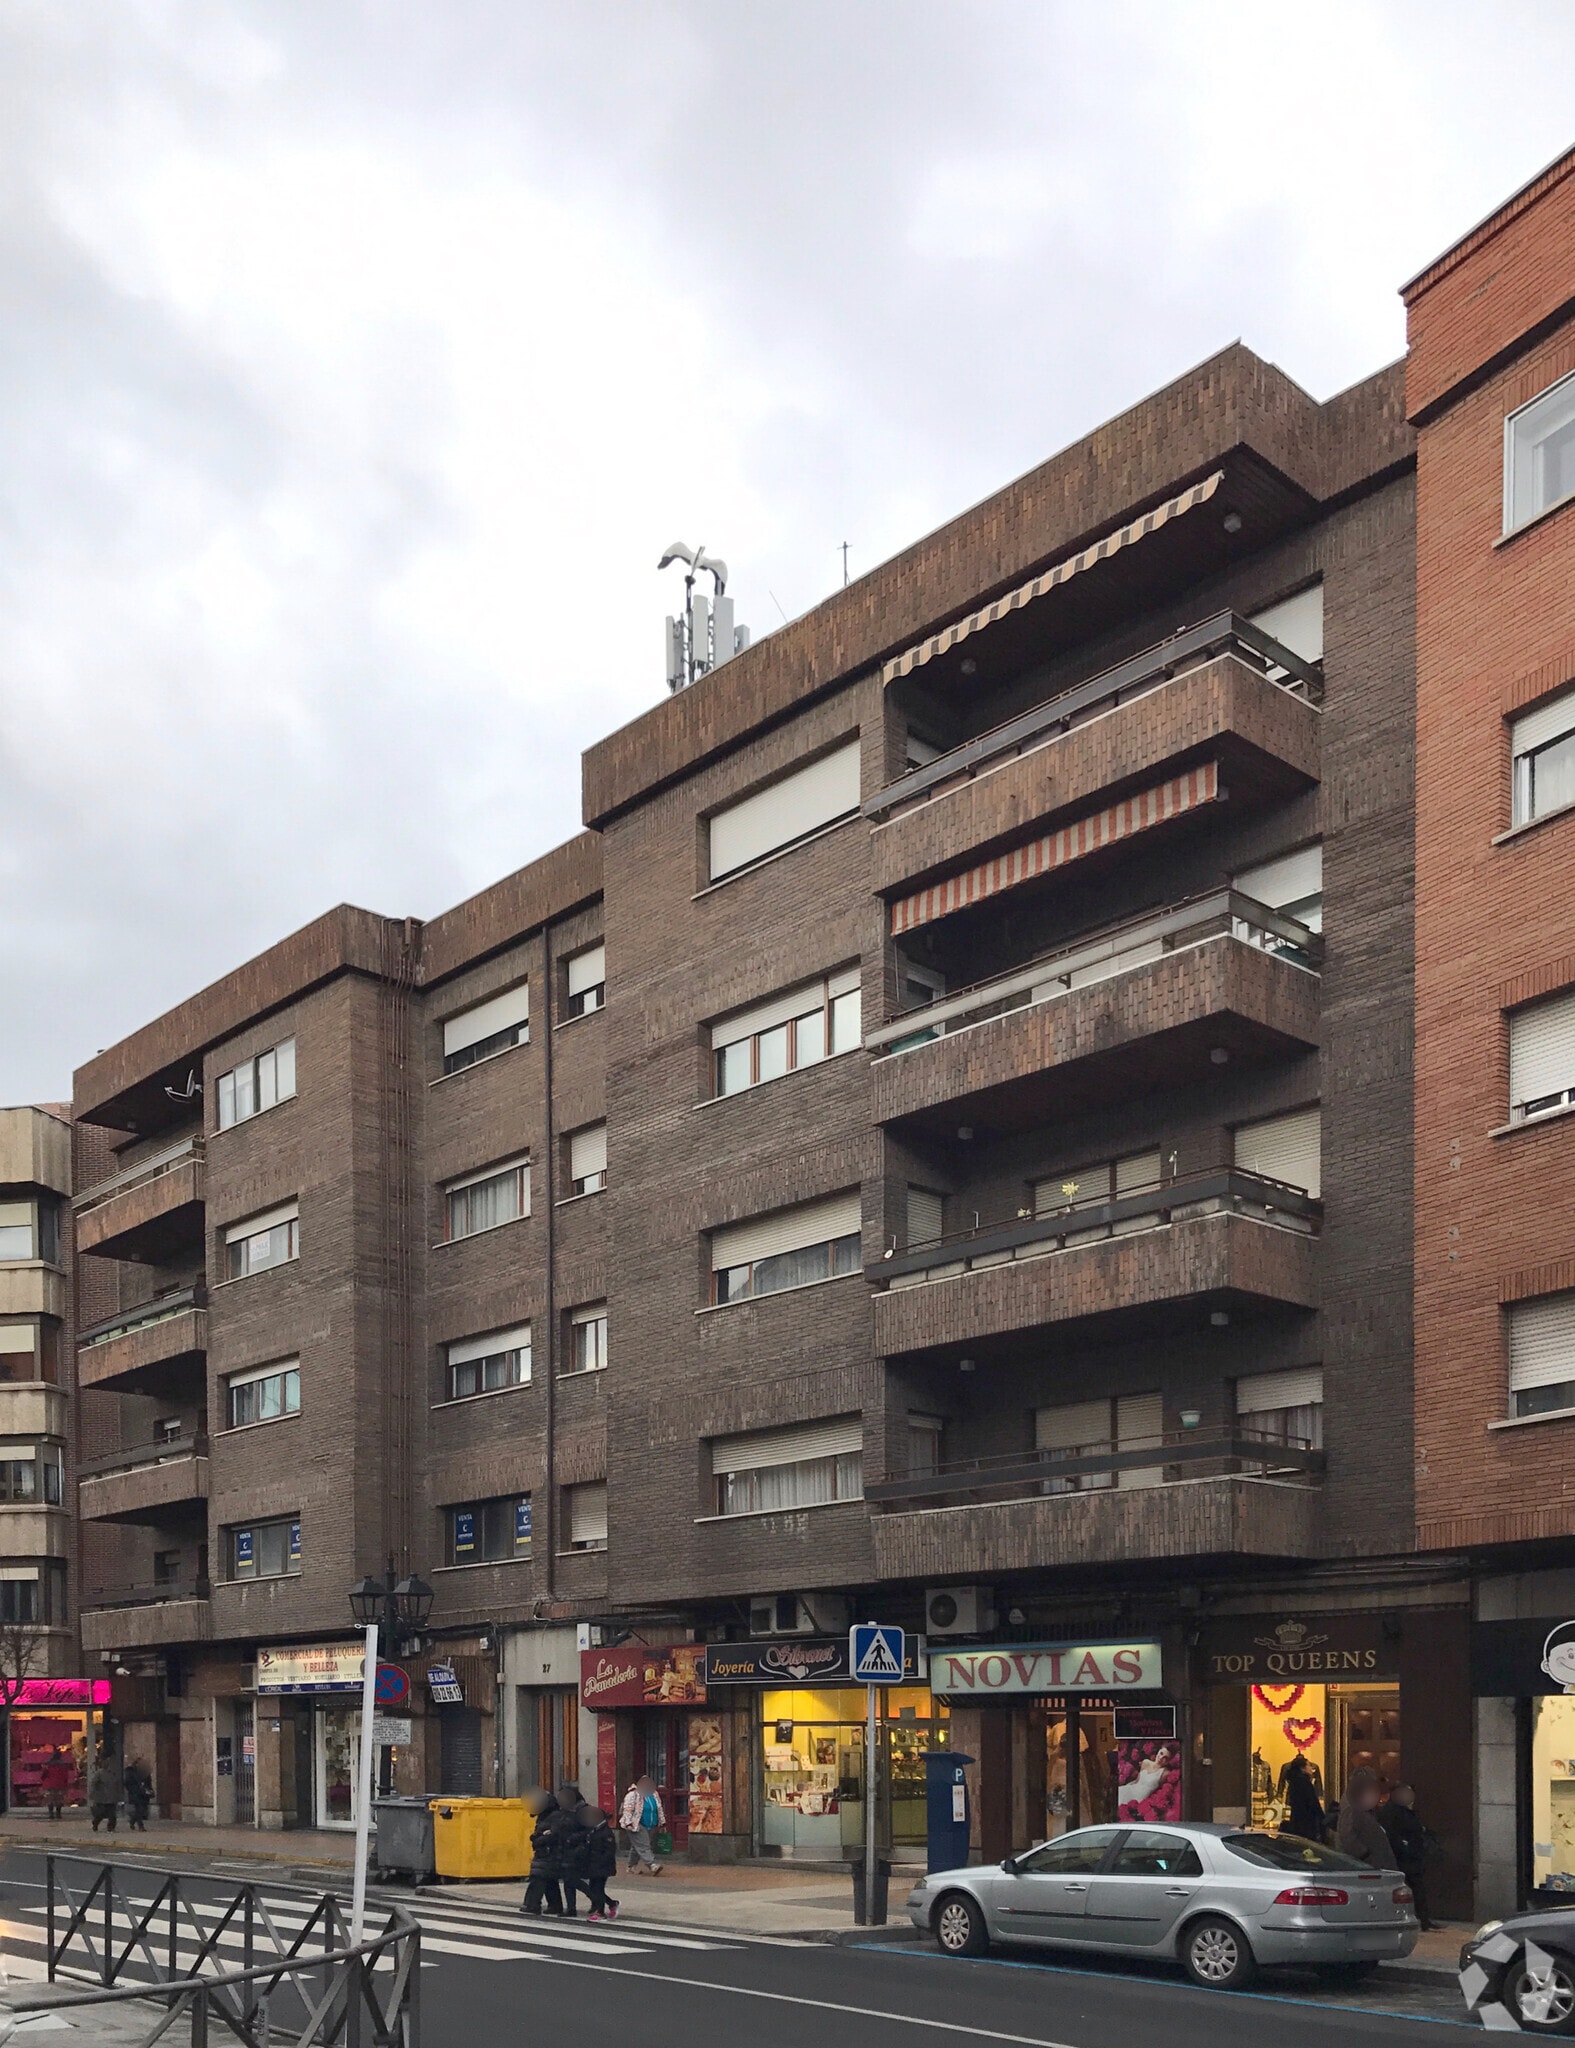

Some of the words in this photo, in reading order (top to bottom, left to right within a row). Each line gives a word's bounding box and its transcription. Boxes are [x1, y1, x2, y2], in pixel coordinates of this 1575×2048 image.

[458, 1513, 473, 1521] VENTA
[275, 1650, 313, 1661] COMERCIAL
[315, 1649, 324, 1659] DE
[325, 1643, 366, 1659] PELUQUERÍ
[303, 1664, 308, 1673] Y
[309, 1662, 339, 1673] BELLEZA
[596, 1658, 613, 1680] La
[711, 1659, 755, 1677] Joyería
[945, 1650, 1143, 1689] NOVIAS
[1212, 1655, 1256, 1673] TOP
[1267, 1650, 1377, 1676] QUEENS
[955, 1767, 964, 1782] P
